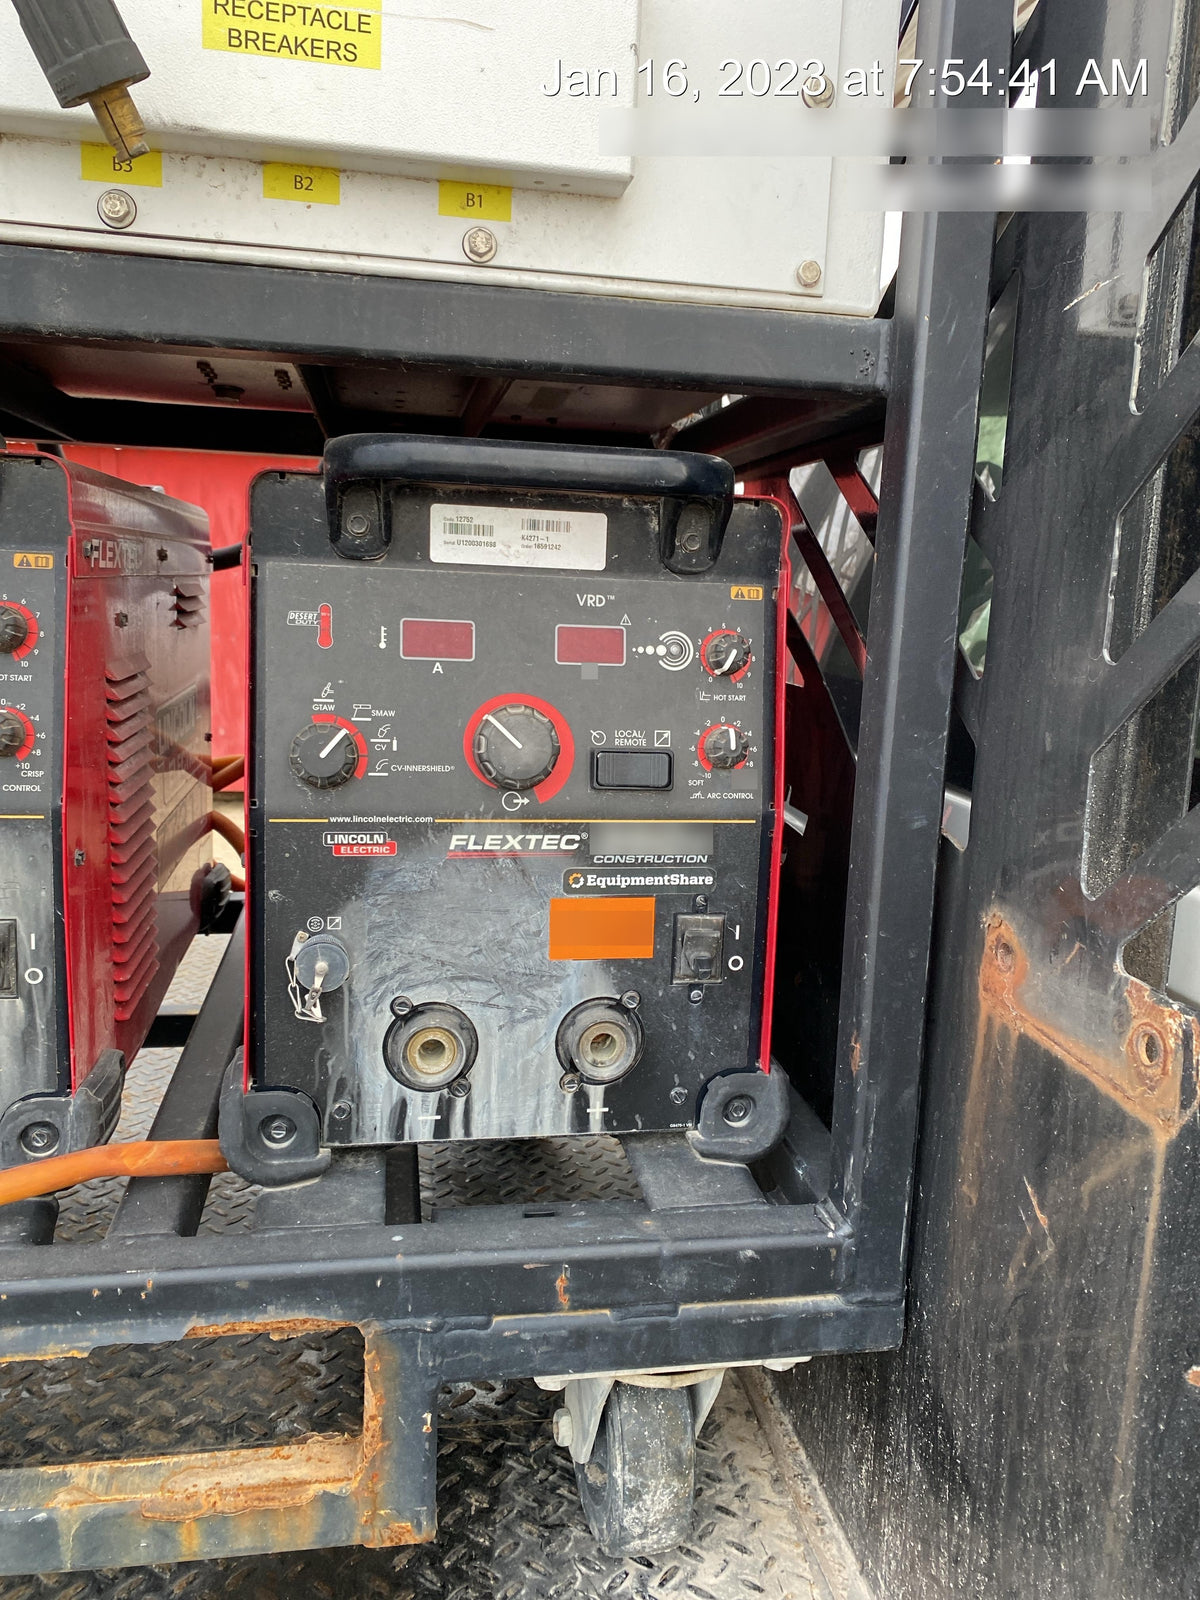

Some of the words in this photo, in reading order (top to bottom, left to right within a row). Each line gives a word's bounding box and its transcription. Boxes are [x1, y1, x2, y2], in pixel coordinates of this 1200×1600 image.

[213, 0, 372, 34] RECEPTACLE
[227, 27, 358, 63] BREAKERS
[112, 155, 133, 173] B3
[293, 175, 314, 193] B2
[464, 192, 484, 209] B1
[288, 612, 318, 620] DESERT
[33, 648, 39, 656] 9
[20, 660, 29, 668] 10
[432, 662, 444, 674] A
[9, 674, 33, 682] START
[312, 703, 336, 712] GTAW
[371, 709, 396, 717] SMAW
[614, 729, 646, 738] LOCAL/
[374, 743, 387, 751] CV
[614, 738, 647, 747] REMOTE
[16, 762, 30, 770] +10
[21, 770, 45, 778] CRISP
[2, 784, 42, 792] CONTROL
[722, 792, 754, 800] CONTROL
[329, 814, 433, 824] www.lincolnelectric.com
[325, 834, 385, 845] LINCOLN
[340, 844, 391, 855] ELECTRIC
[592, 854, 708, 864] CONSTRUCTION
[585, 873, 714, 888] EquipmentShare
